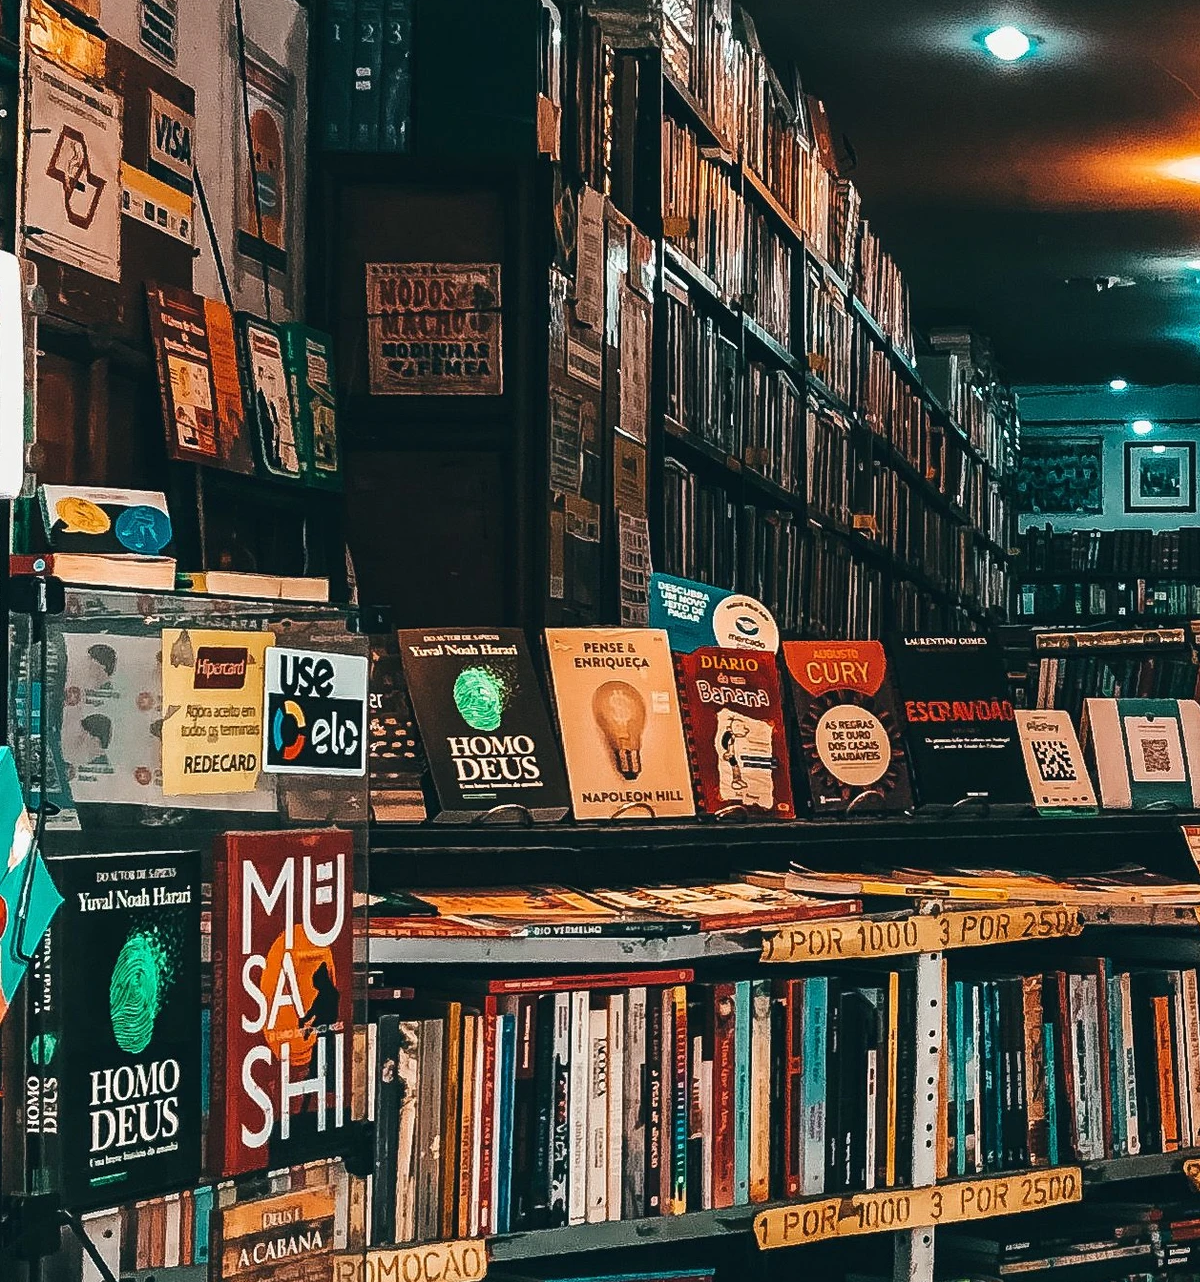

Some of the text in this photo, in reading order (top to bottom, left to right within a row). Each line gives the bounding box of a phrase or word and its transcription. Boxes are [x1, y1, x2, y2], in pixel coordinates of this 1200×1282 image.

[361, 23, 375, 44] 2
[389, 21, 402, 45] 3
[154, 111, 192, 168] VISA
[657, 581, 710, 602] DESCUBRA
[660, 591, 707, 608] UM NOVO
[662, 600, 705, 616] JEITO DE
[667, 608, 701, 623] PAGAR
[409, 643, 519, 658] Yuval Noah Harari
[584, 642, 636, 654] PENSE &
[727, 633, 766, 649] mercado
[574, 656, 650, 671] ENRIQUEÇA
[812, 648, 860, 660] AUGUSTO
[196, 658, 246, 680] Hipercard
[279, 654, 335, 698] use
[806, 660, 870, 685] CURY
[695, 679, 771, 708] Banana
[185, 704, 256, 720] Agora aceito em
[181, 724, 206, 737] todos
[219, 723, 260, 737] terminais
[311, 711, 359, 756] elo
[825, 719, 875, 731] AS REGRAS
[831, 730, 872, 741] DE OURO
[447, 735, 535, 756] HOMO
[828, 741, 880, 752] DOS CASAIS
[183, 753, 257, 775] REDECARD
[452, 757, 540, 782] DEUS
[582, 790, 684, 803] NAPOLEON HILL
[77, 884, 192, 912] Yuval Noah Harari
[789, 928, 844, 956] POR
[939, 918, 950, 946] 3
[961, 913, 1011, 942] POR
[241, 952, 306, 1034] SA
[89, 1058, 181, 1107] HOMO
[241, 1032, 344, 1148] SHI
[26, 1075, 40, 1134] HOMO
[43, 1076, 58, 1135] DEUS
[89, 1096, 180, 1153] DEUS
[758, 1219, 769, 1245] 1
[783, 1205, 838, 1239] POR
[931, 1191, 943, 1220] 3
[960, 1184, 1008, 1214] POR
[237, 1229, 324, 1269] A CABANA
